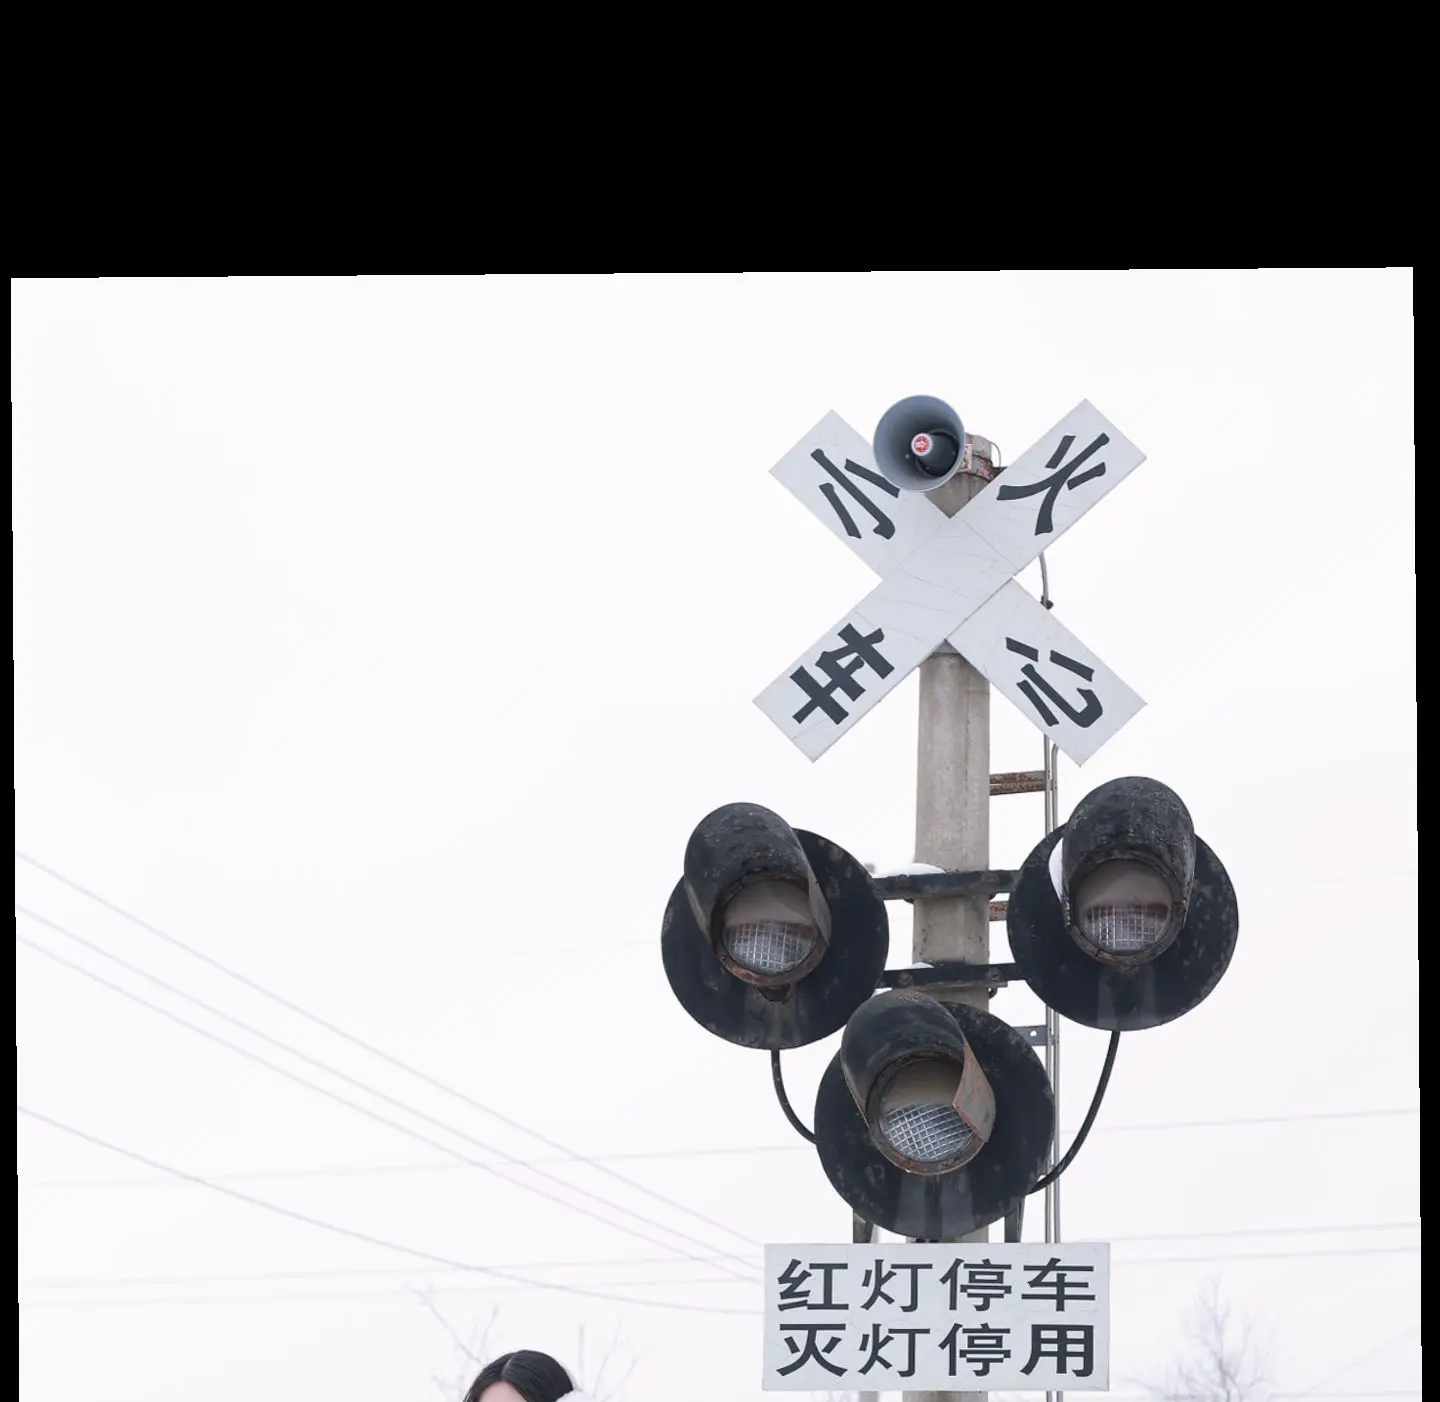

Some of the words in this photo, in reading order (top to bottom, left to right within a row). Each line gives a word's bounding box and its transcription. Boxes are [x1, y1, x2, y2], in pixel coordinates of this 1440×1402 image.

[776, 1257, 1096, 1313] 红灯停车
[775, 1322, 1095, 1378] 灭灯停用
